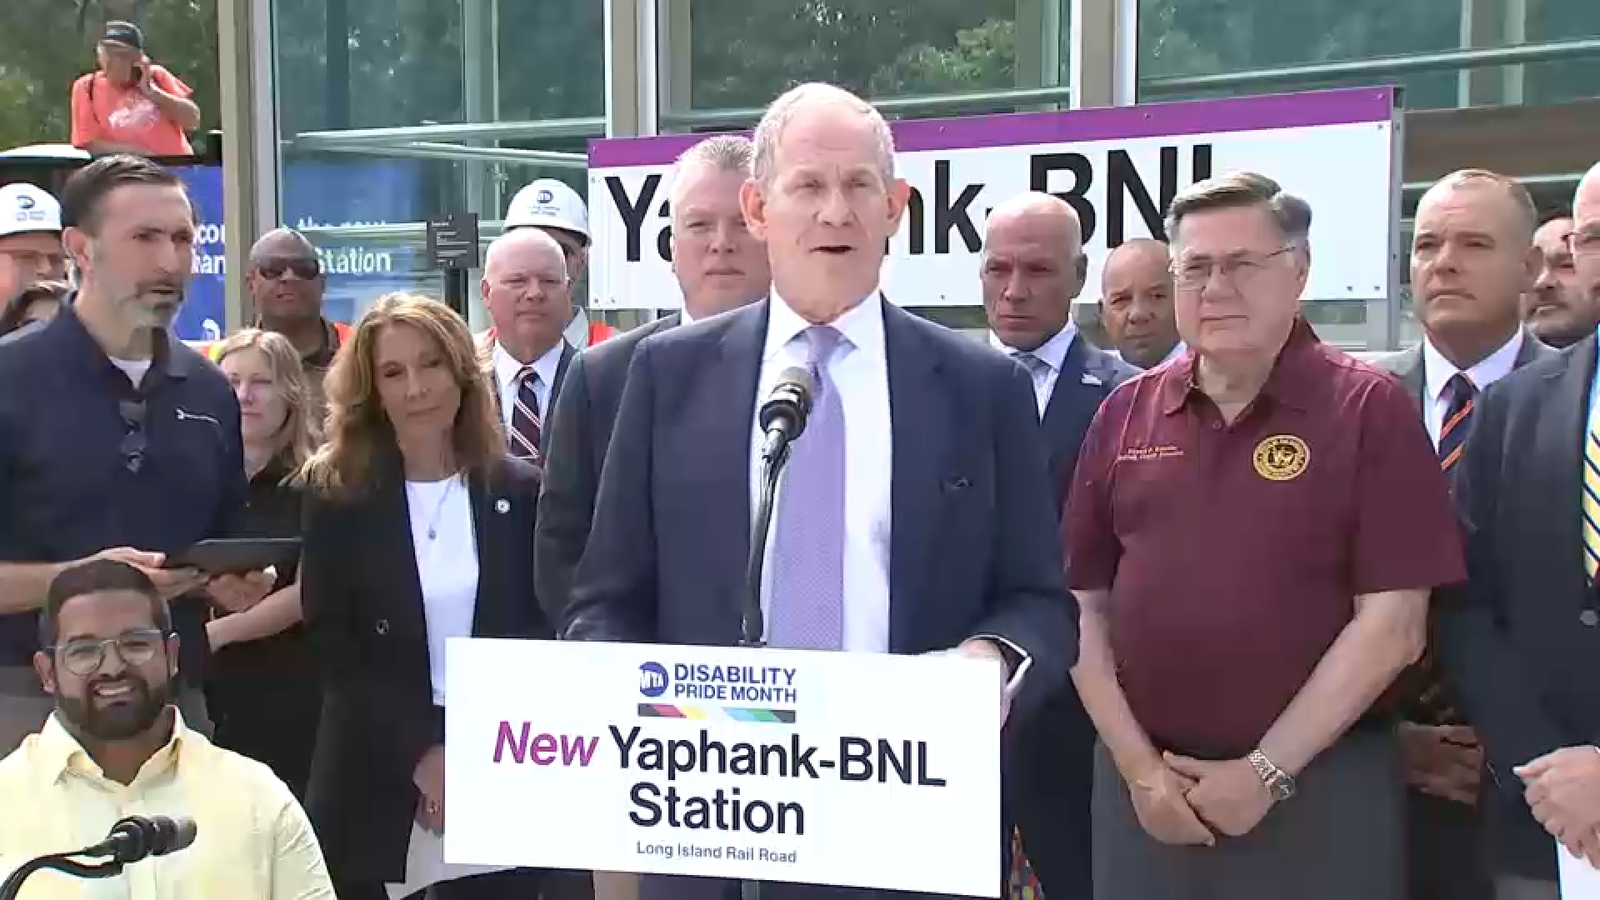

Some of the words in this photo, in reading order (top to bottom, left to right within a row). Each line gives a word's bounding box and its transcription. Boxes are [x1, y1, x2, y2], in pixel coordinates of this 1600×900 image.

[639, 666, 667, 691] MTA
[674, 663, 797, 686] DISABILITY
[674, 683, 728, 700] PRIDE
[731, 685, 797, 704] MONTH
[493, 721, 600, 767] New
[608, 725, 947, 787] Yaphank-BNL
[628, 782, 805, 835] Station
[637, 841, 673, 859] Long
[677, 843, 722, 859] Island
[726, 846, 755, 861] Rail
[759, 847, 797, 863] Road
